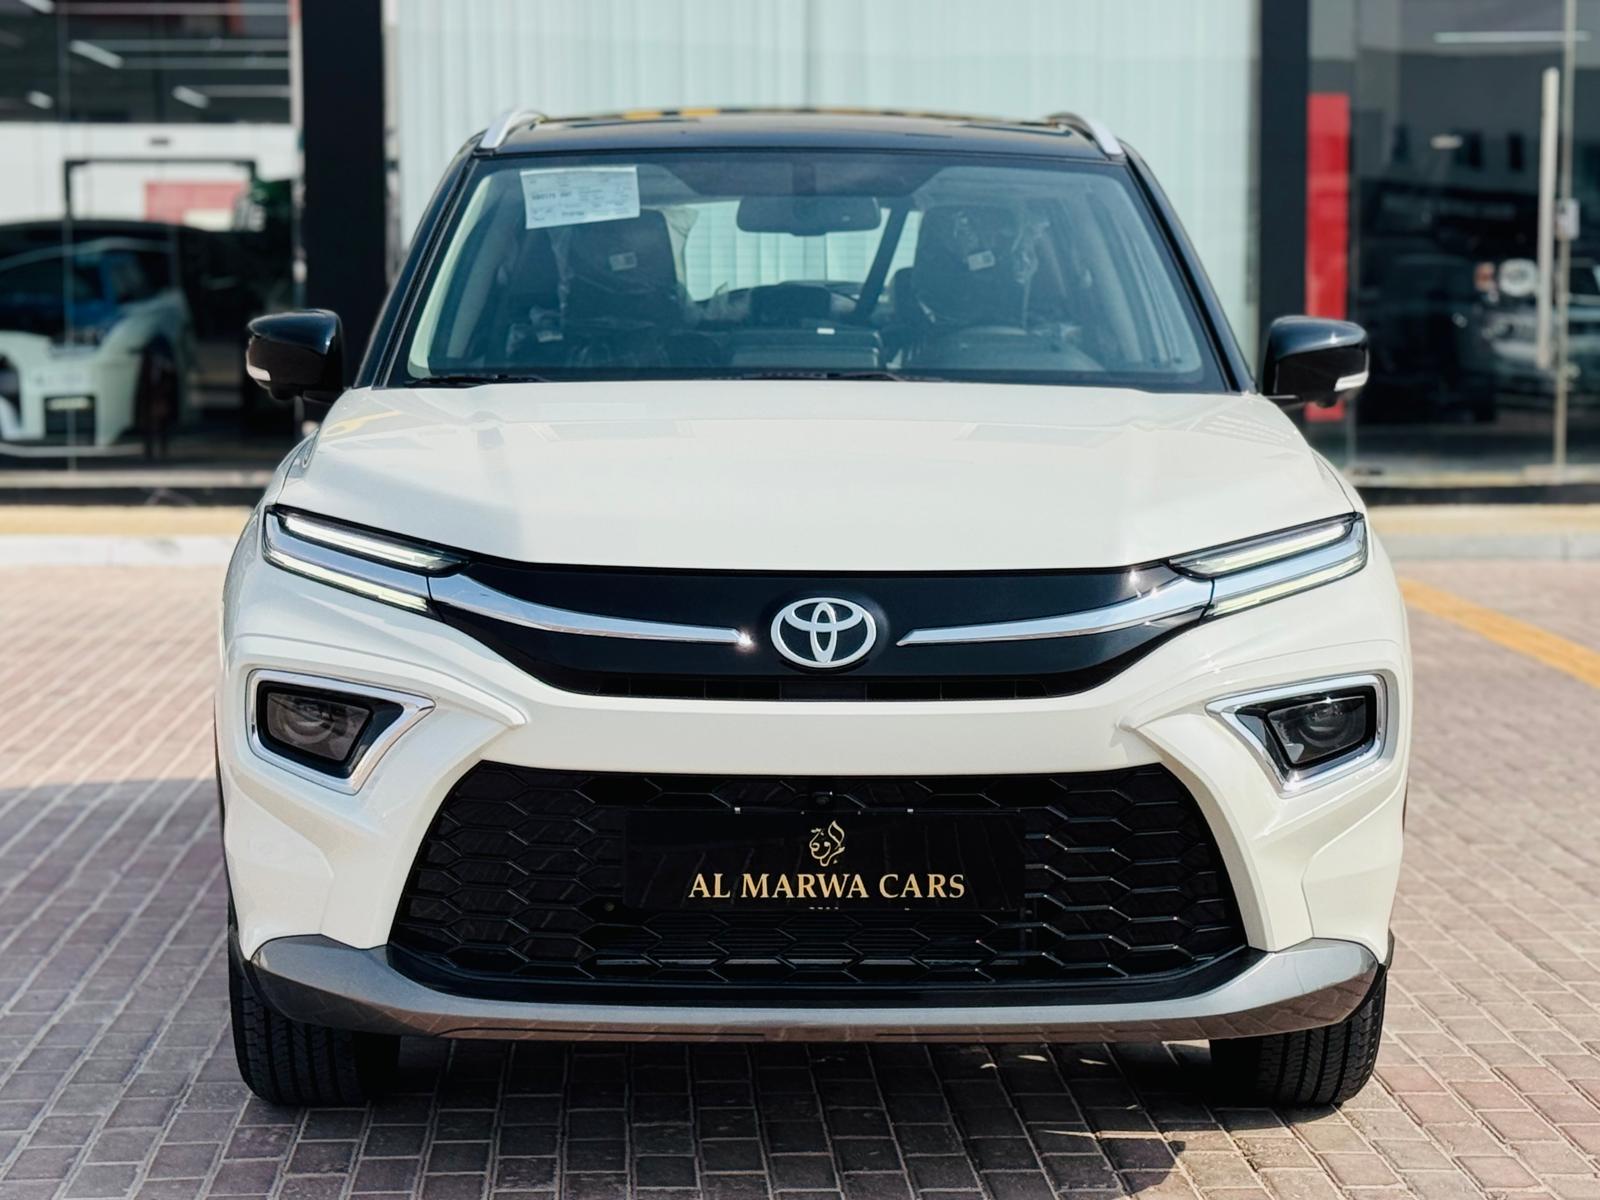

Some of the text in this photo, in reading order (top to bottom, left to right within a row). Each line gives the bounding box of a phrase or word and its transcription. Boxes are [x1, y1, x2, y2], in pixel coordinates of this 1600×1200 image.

[688, 873, 965, 899] AL MARWA CARS
